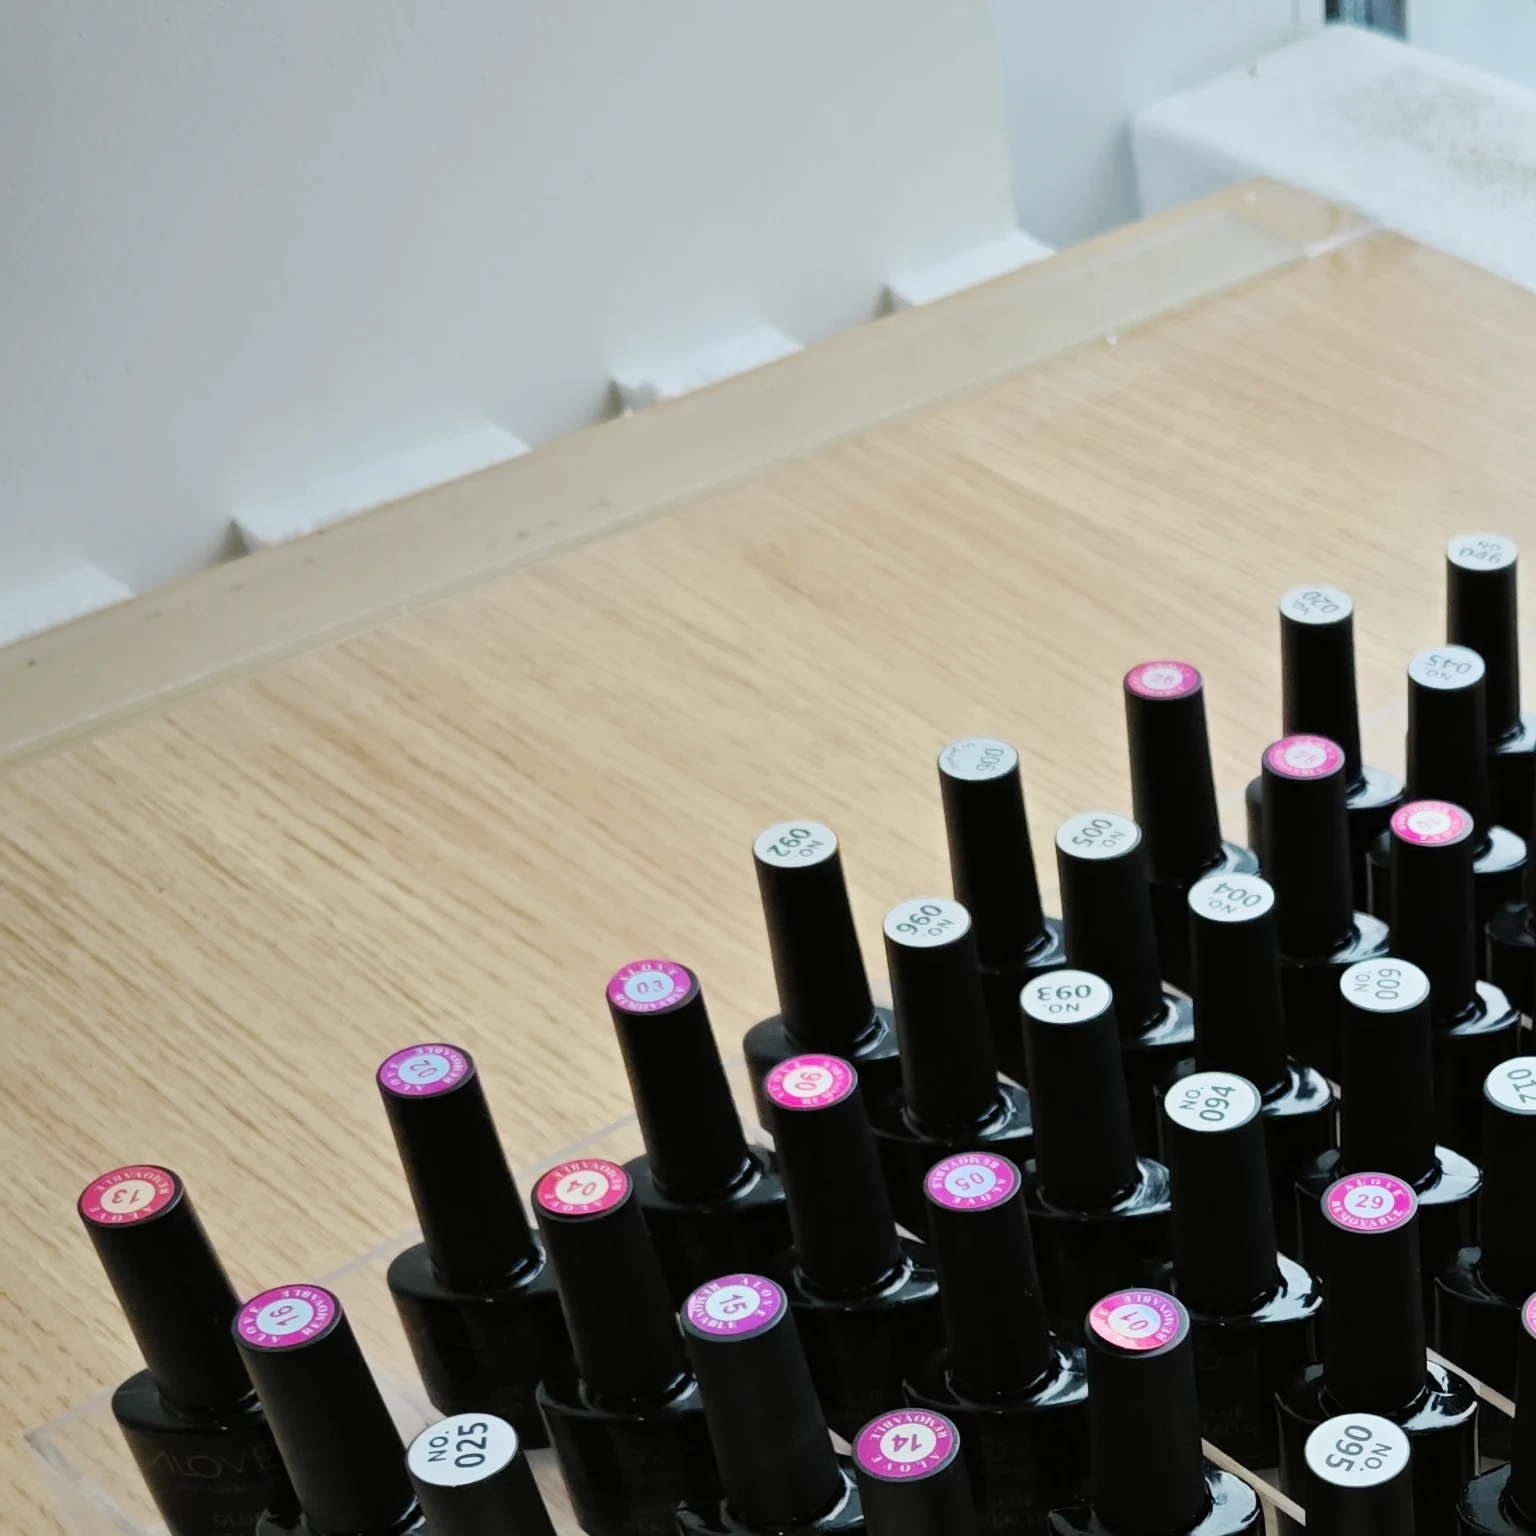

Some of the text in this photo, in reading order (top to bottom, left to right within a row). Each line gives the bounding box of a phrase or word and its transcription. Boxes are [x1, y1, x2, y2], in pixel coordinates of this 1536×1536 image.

[766, 829, 812, 857] 092
[1072, 819, 1112, 847] 005
[1216, 882, 1262, 907] 004
[896, 904, 943, 935] 096
[619, 962, 679, 978] ALOVE
[1353, 970, 1371, 991] NO.
[636, 979, 665, 995] 03
[1037, 985, 1092, 1001] 093
[1375, 969, 1401, 1000] 009
[617, 986, 688, 1012] REMOVABLE
[1043, 1002, 1080, 1014] NO.
[409, 1059, 438, 1078] 02
[793, 1072, 824, 1090] 06
[1181, 1086, 1204, 1110] NO.
[1199, 1085, 1236, 1121] 094
[102, 1170, 170, 1196] REMOVABLE
[552, 1162, 621, 1190] REMOVABLE
[930, 1157, 999, 1189] REMOVABLE
[956, 1173, 985, 1190] 05
[111, 1189, 141, 1205] 13
[566, 1180, 598, 1195] 04
[951, 1179, 1007, 1207] ALOVE
[1343, 1178, 1403, 1198] ALOVE
[98, 1200, 153, 1221] ALOVE
[544, 1192, 603, 1211] ALOVE
[1355, 1194, 1384, 1209] 29
[1331, 1201, 1405, 1229] REMOVABLE
[695, 1283, 737, 1331] REMOVABLE
[718, 1294, 749, 1314] 15
[740, 1277, 774, 1317] ALOVE
[239, 1306, 278, 1344] ALOVE
[268, 1306, 298, 1328] 16
[280, 1290, 333, 1336] REMOVABLE
[1119, 1312, 1145, 1331] 01
[1124, 1295, 1174, 1340] REMOVABLE
[870, 1414, 948, 1442] REMOVABLE
[428, 1430, 450, 1462] NO.
[455, 1422, 488, 1468] 025
[892, 1434, 922, 1451] 14
[1325, 1425, 1374, 1472] 095
[870, 1450, 940, 1472] ALOVE
[1358, 1444, 1393, 1472] NO.
